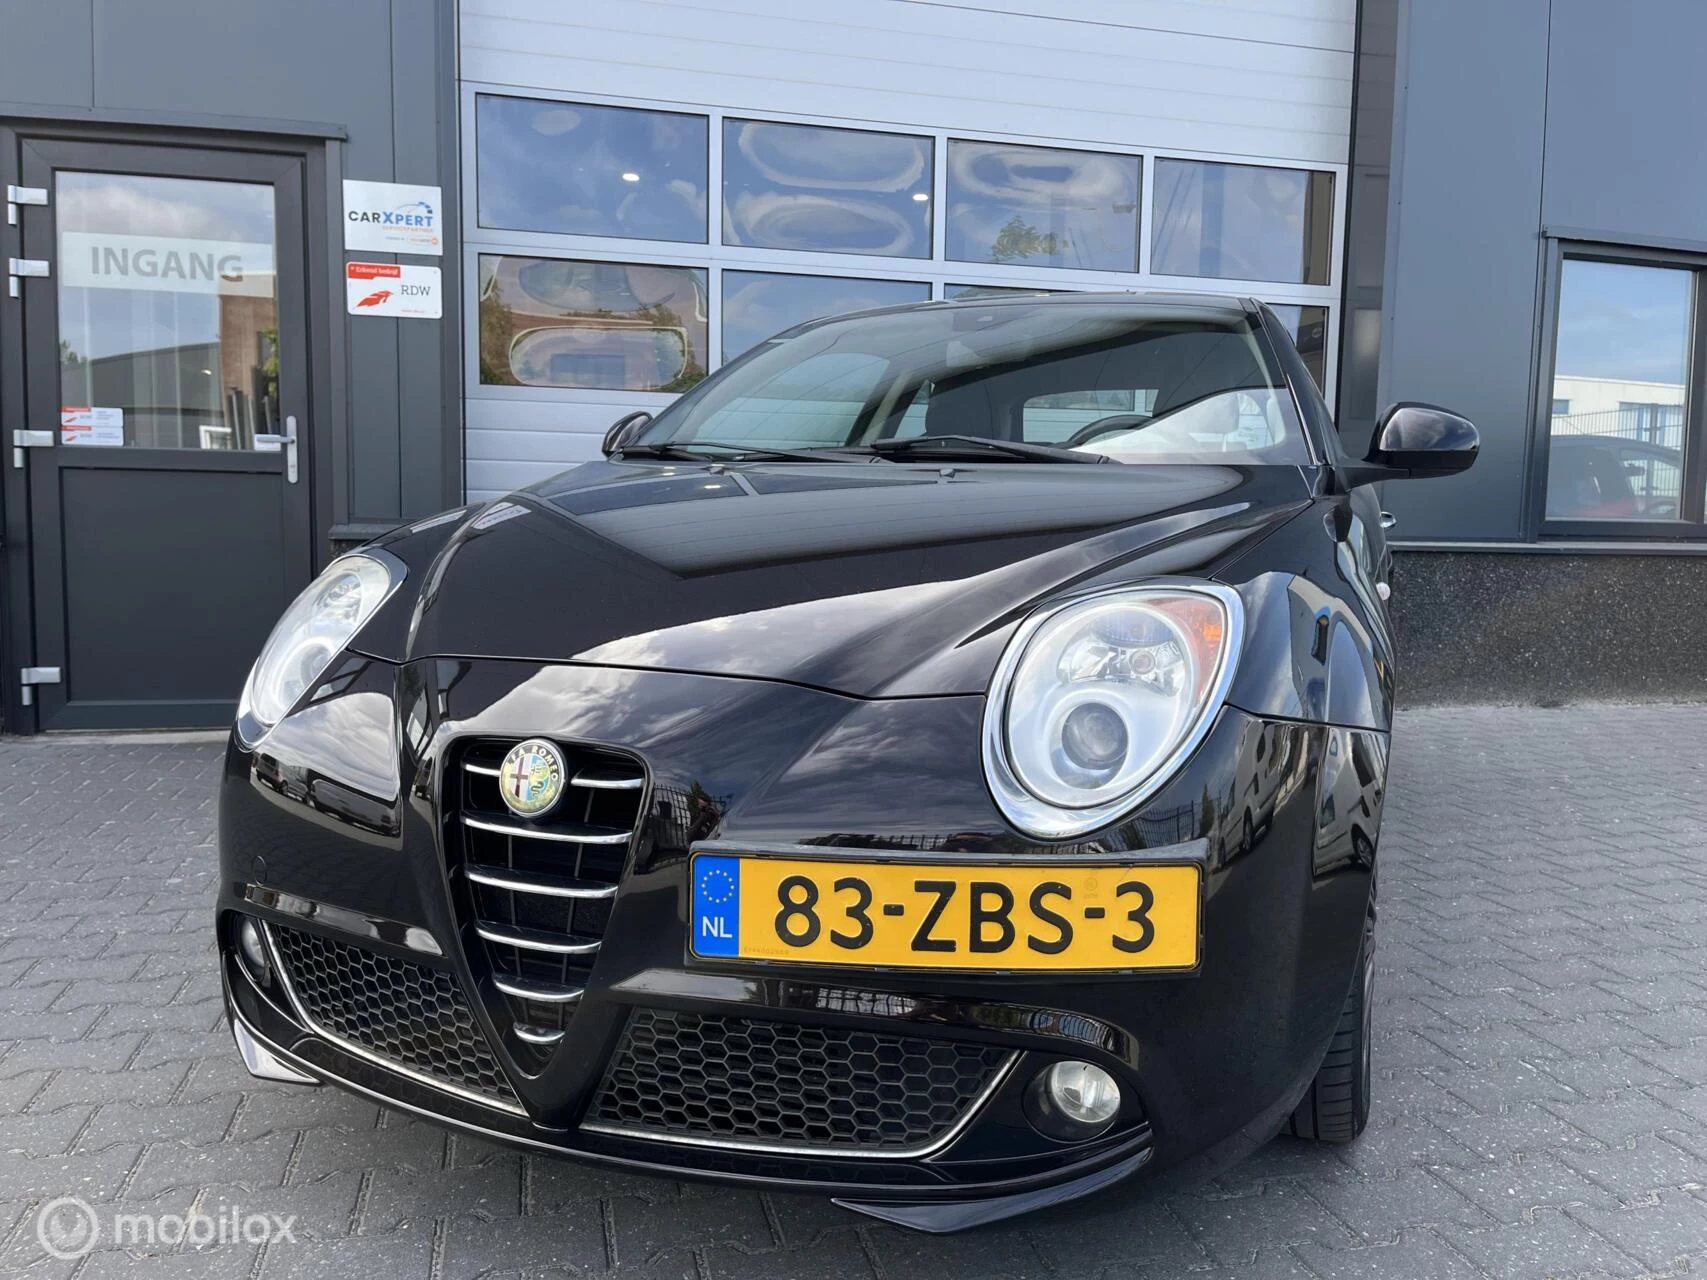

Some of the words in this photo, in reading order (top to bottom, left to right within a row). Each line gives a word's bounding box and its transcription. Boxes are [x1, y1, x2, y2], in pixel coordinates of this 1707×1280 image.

[348, 210, 433, 227] CARXPERT
[91, 246, 243, 282] INGANG
[401, 285, 431, 296] RDW
[532, 745, 559, 781] ROMEO
[702, 915, 733, 939] NL
[774, 875, 1156, 955] 83-ZBS-3
